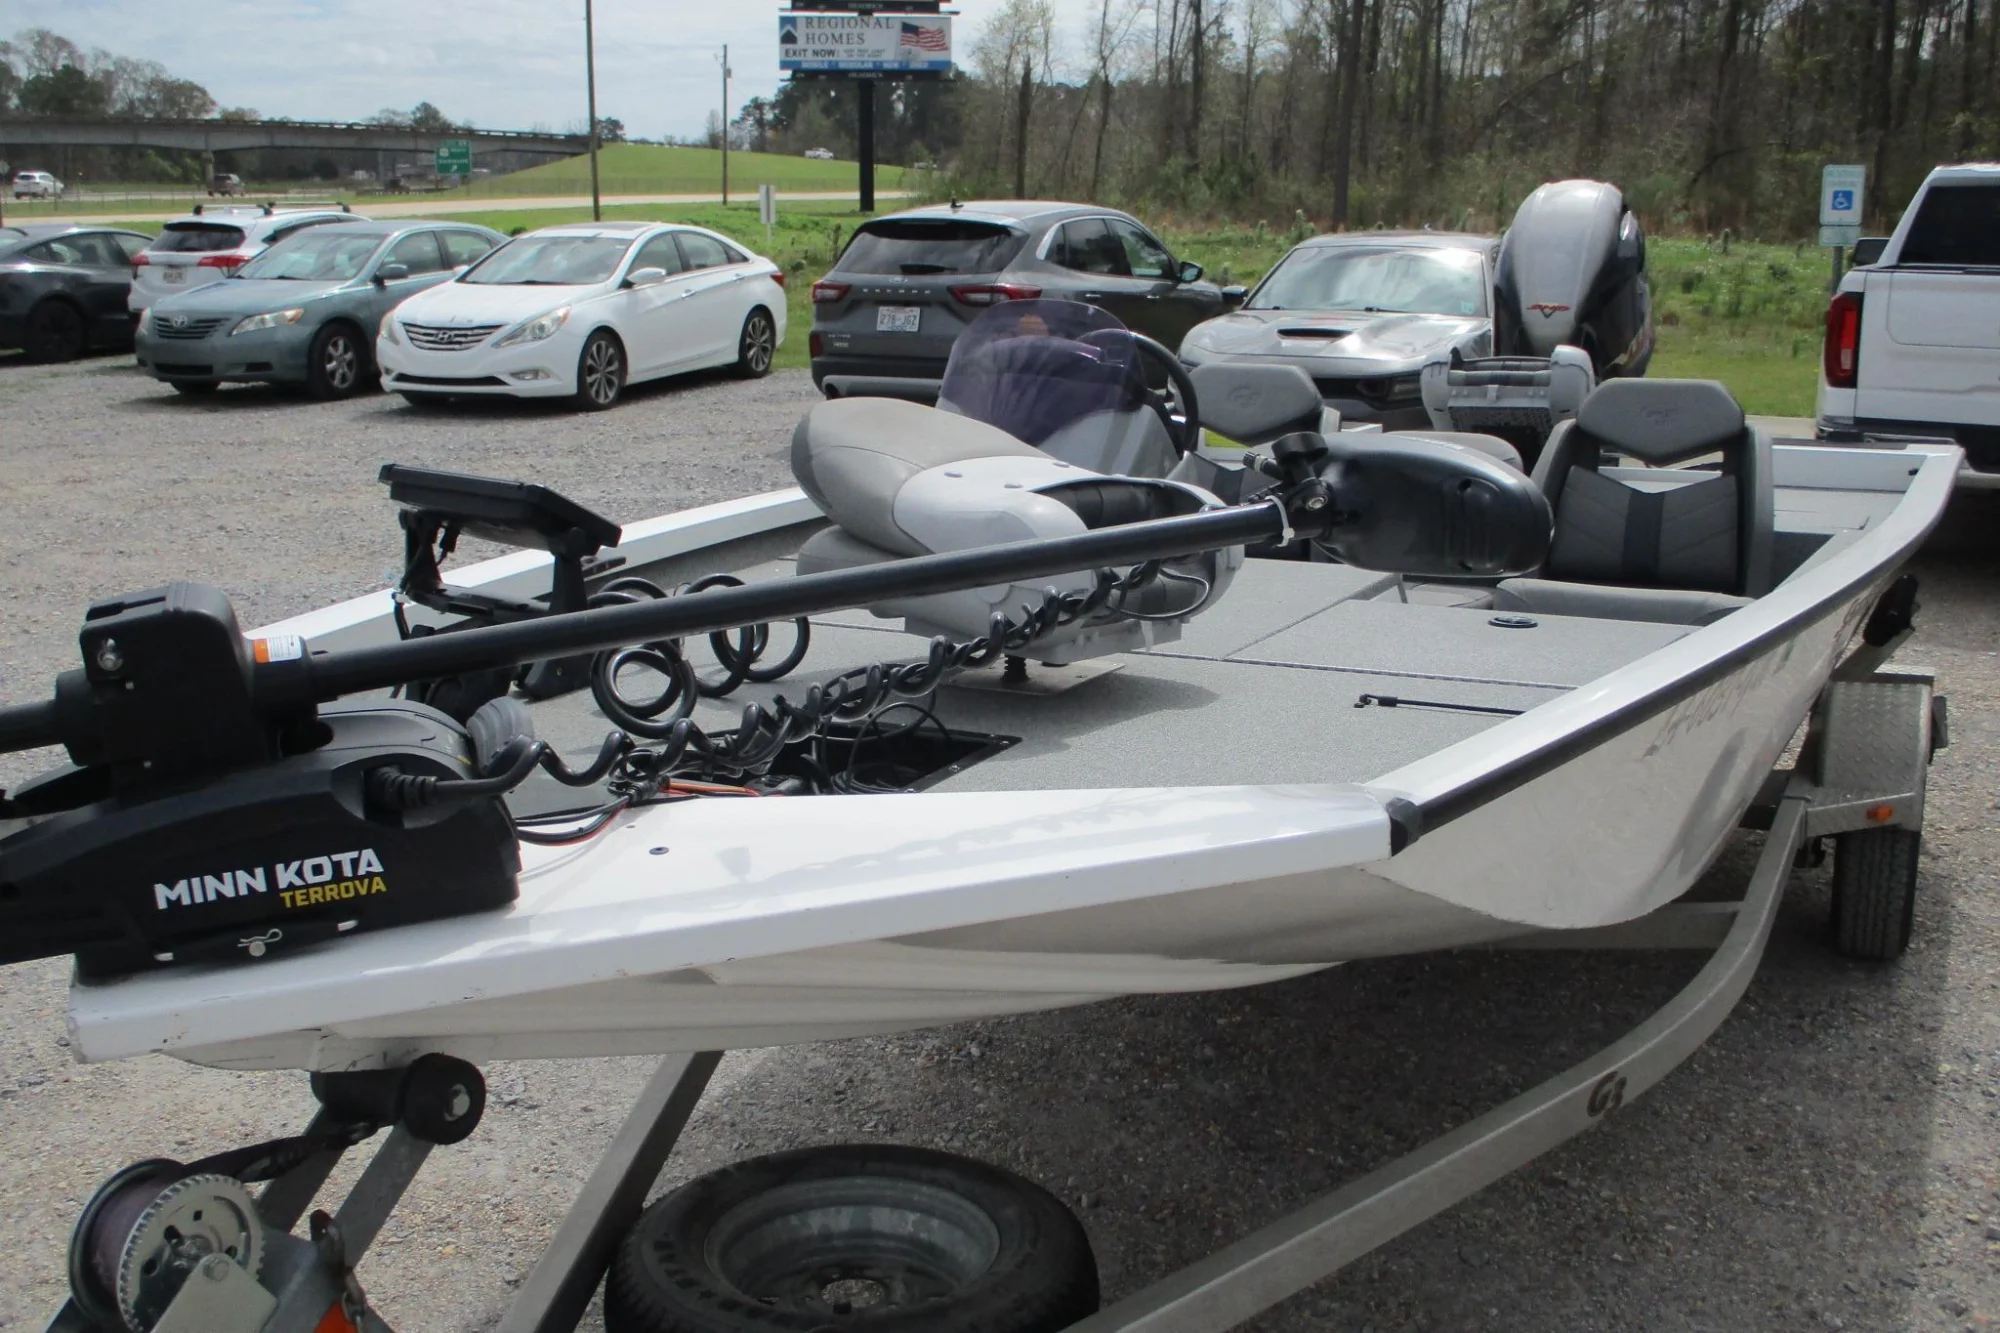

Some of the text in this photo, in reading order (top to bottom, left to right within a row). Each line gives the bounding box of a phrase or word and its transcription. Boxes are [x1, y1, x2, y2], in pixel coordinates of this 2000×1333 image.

[805, 17, 894, 29] REGIONAL
[805, 32, 866, 45] HOMES
[784, 48, 808, 58] EXIT
[153, 848, 385, 910] MINN KOTA
[280, 876, 387, 908] TERROVA
